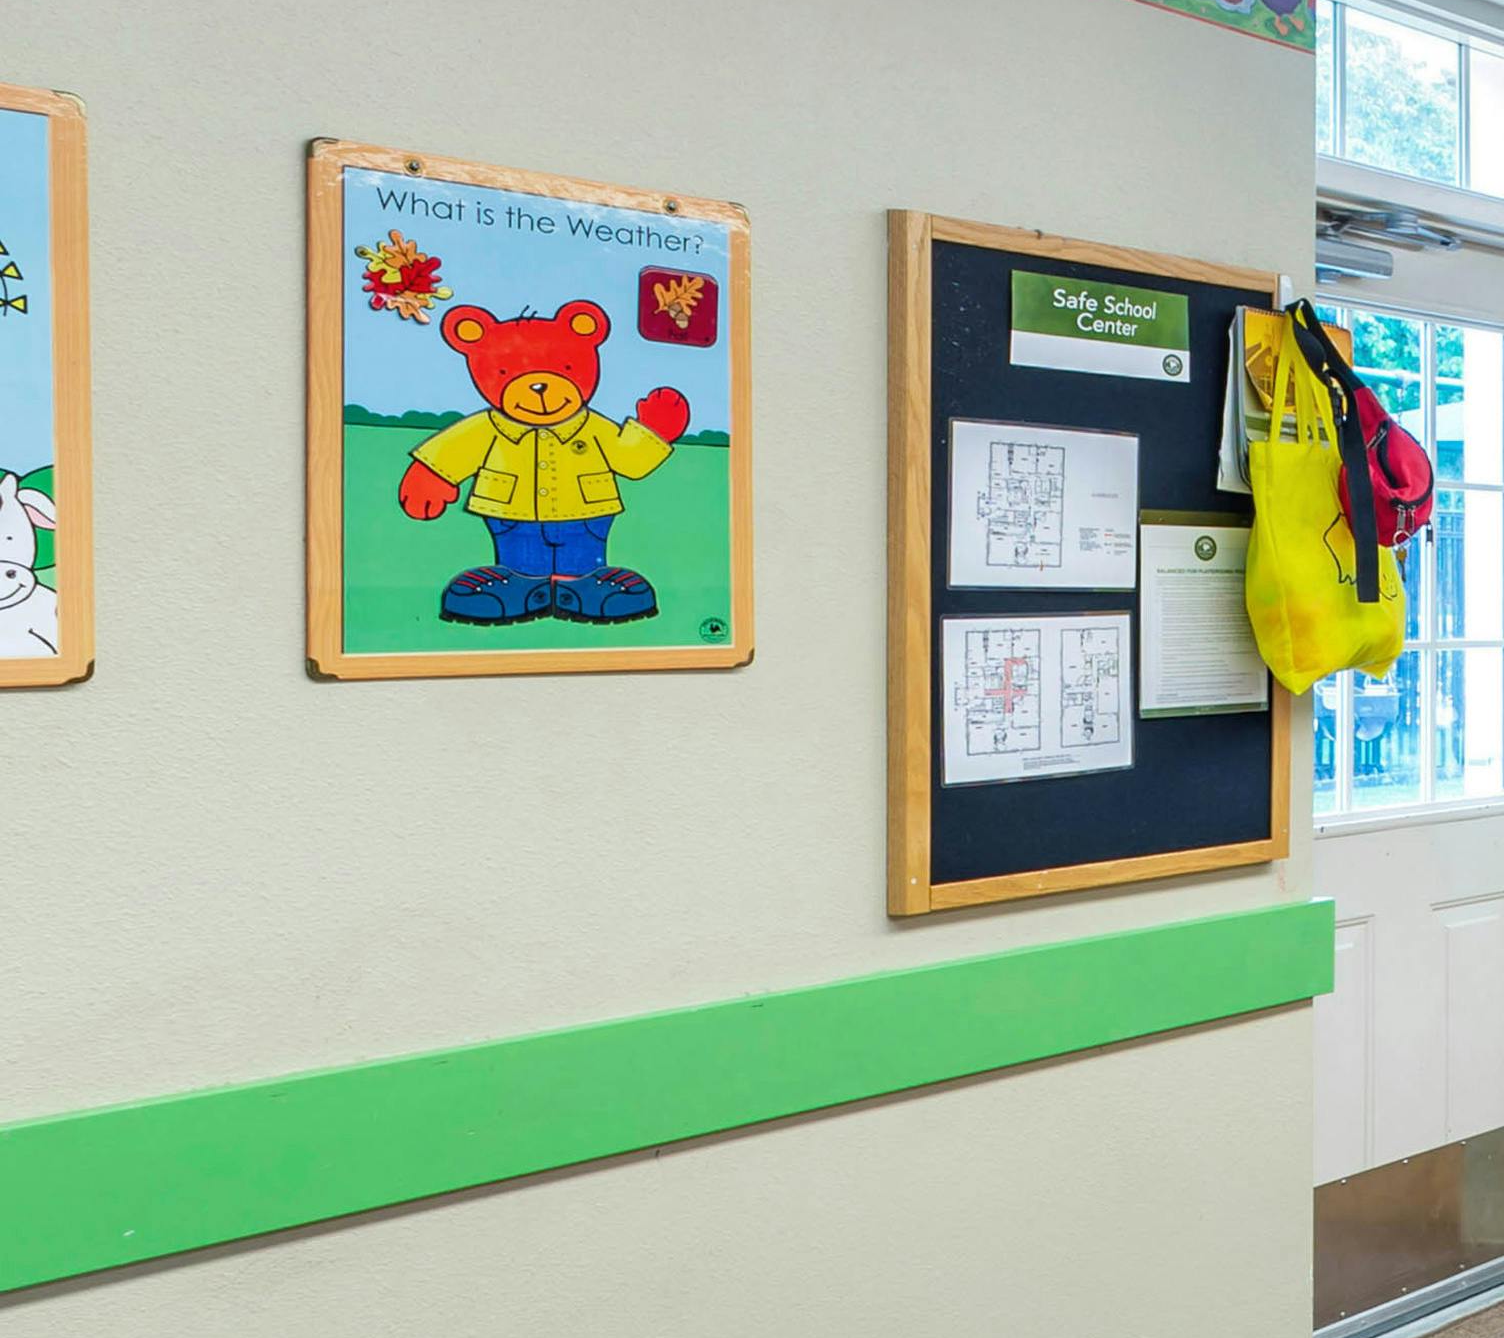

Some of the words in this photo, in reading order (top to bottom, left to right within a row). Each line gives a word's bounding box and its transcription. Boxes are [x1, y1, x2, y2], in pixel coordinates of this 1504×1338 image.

[376, 187, 466, 222] What
[476, 201, 495, 226] is
[506, 208, 556, 234] the
[566, 214, 705, 255] Weather?
[1053, 289, 1098, 312] Safe
[1104, 296, 1157, 320] School
[1076, 313, 1139, 337] Center
